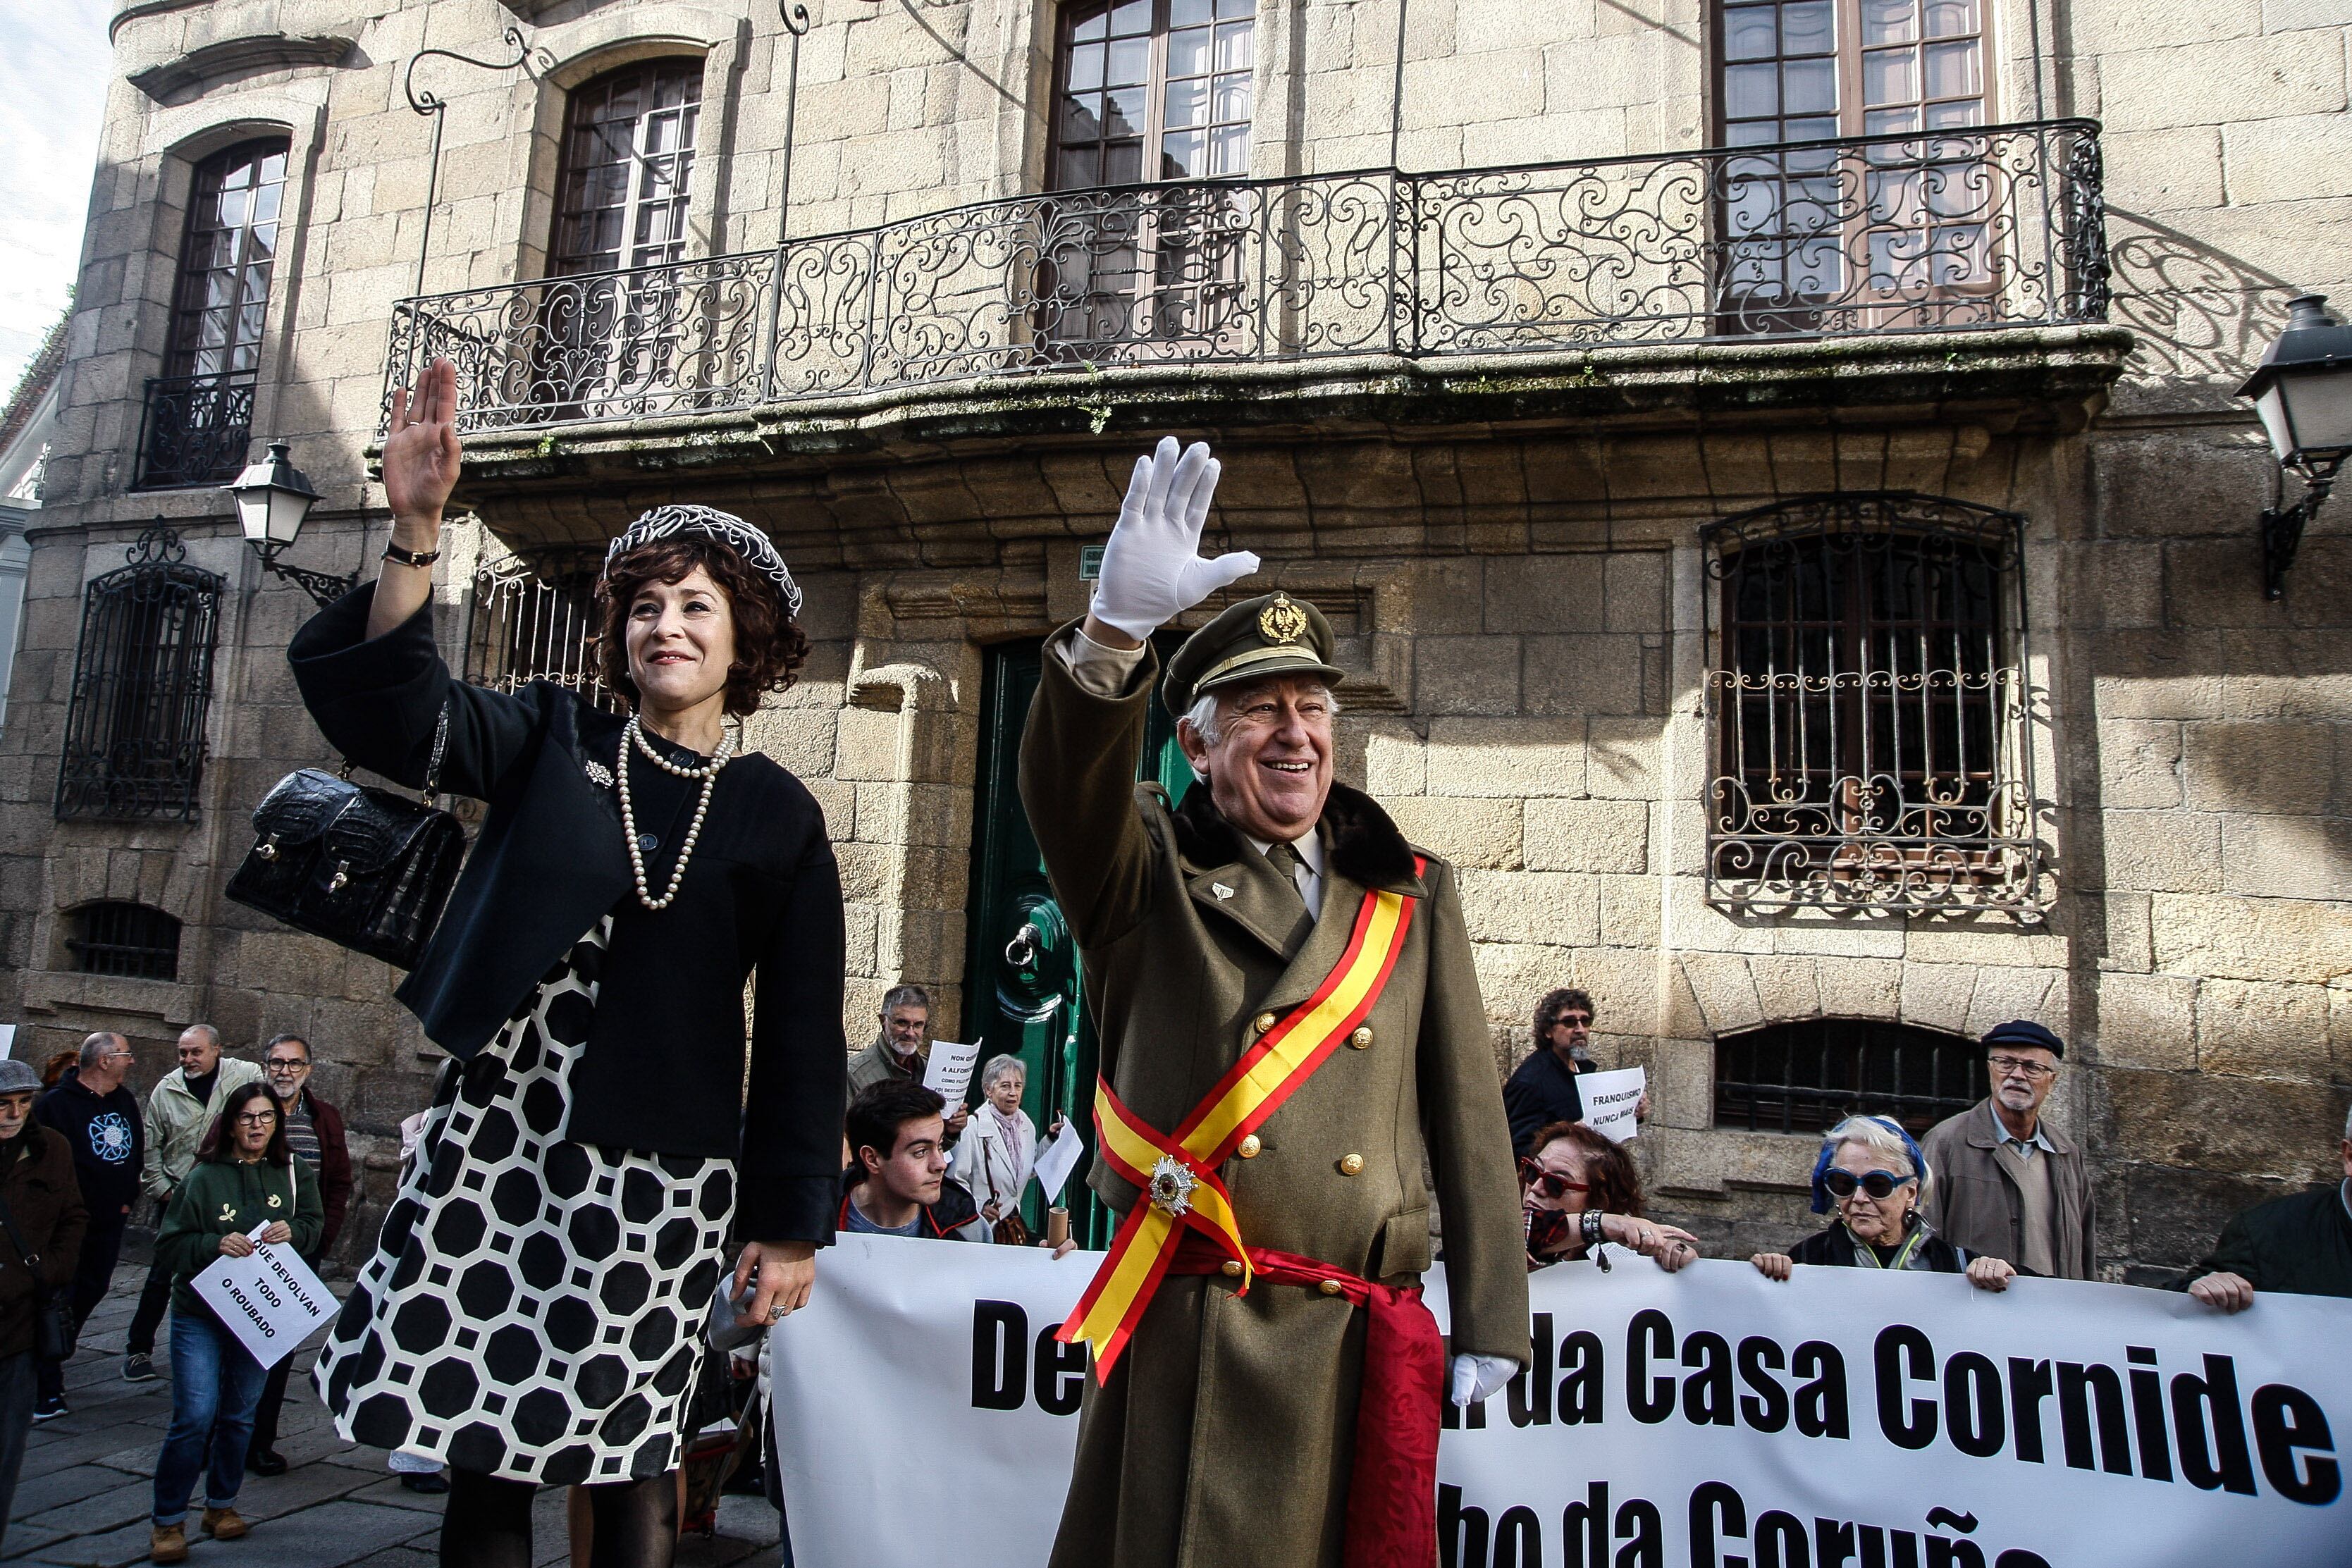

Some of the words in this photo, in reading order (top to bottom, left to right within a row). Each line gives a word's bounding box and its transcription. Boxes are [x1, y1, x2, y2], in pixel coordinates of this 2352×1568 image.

[1593, 1087, 1642, 1106] FRANQUISMO
[1593, 1113, 1619, 1125] NUNCA
[222, 1278, 233, 1288] O
[230, 1288, 276, 1338] ROUBADO
[254, 1239, 275, 1263] QUE
[271, 1261, 321, 1317] DEVOLVAN
[254, 1277, 281, 1308] TODO
[971, 1298, 1088, 1416] De
[1506, 1312, 1604, 1428] da
[1625, 1307, 1851, 1440] Casa
[1873, 1323, 2343, 1507] Cornide
[1688, 1480, 2053, 1568] Corñ
